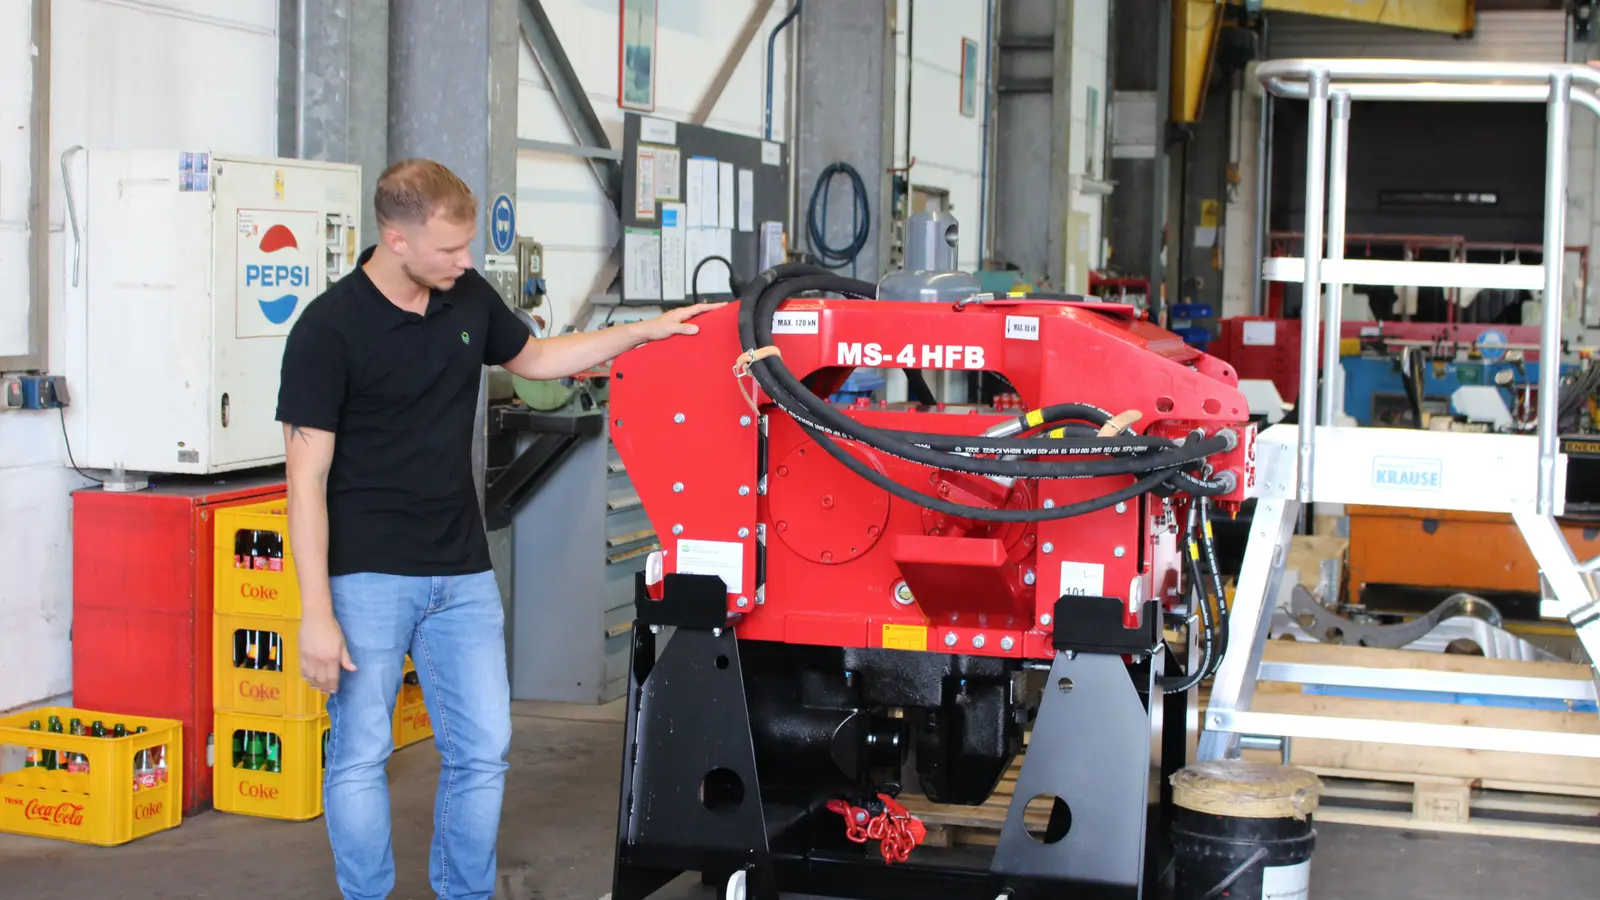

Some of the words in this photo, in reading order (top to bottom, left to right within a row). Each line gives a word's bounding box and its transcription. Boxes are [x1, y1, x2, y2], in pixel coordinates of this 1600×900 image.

[246, 264, 309, 287] PEPSI
[777, 319, 793, 327] MAX.
[795, 319, 807, 327] 120
[807, 319, 817, 327] kN
[921, 344, 985, 369] HFB
[1376, 469, 1438, 486] KRAUSE
[241, 583, 278, 600] Coke
[1065, 586, 1086, 596] 101
[239, 680, 280, 700] Coke
[238, 780, 279, 800] Coke
[4, 797, 24, 806] TRINK
[25, 798, 85, 827] Coca-Cola
[134, 801, 163, 820] Coke
